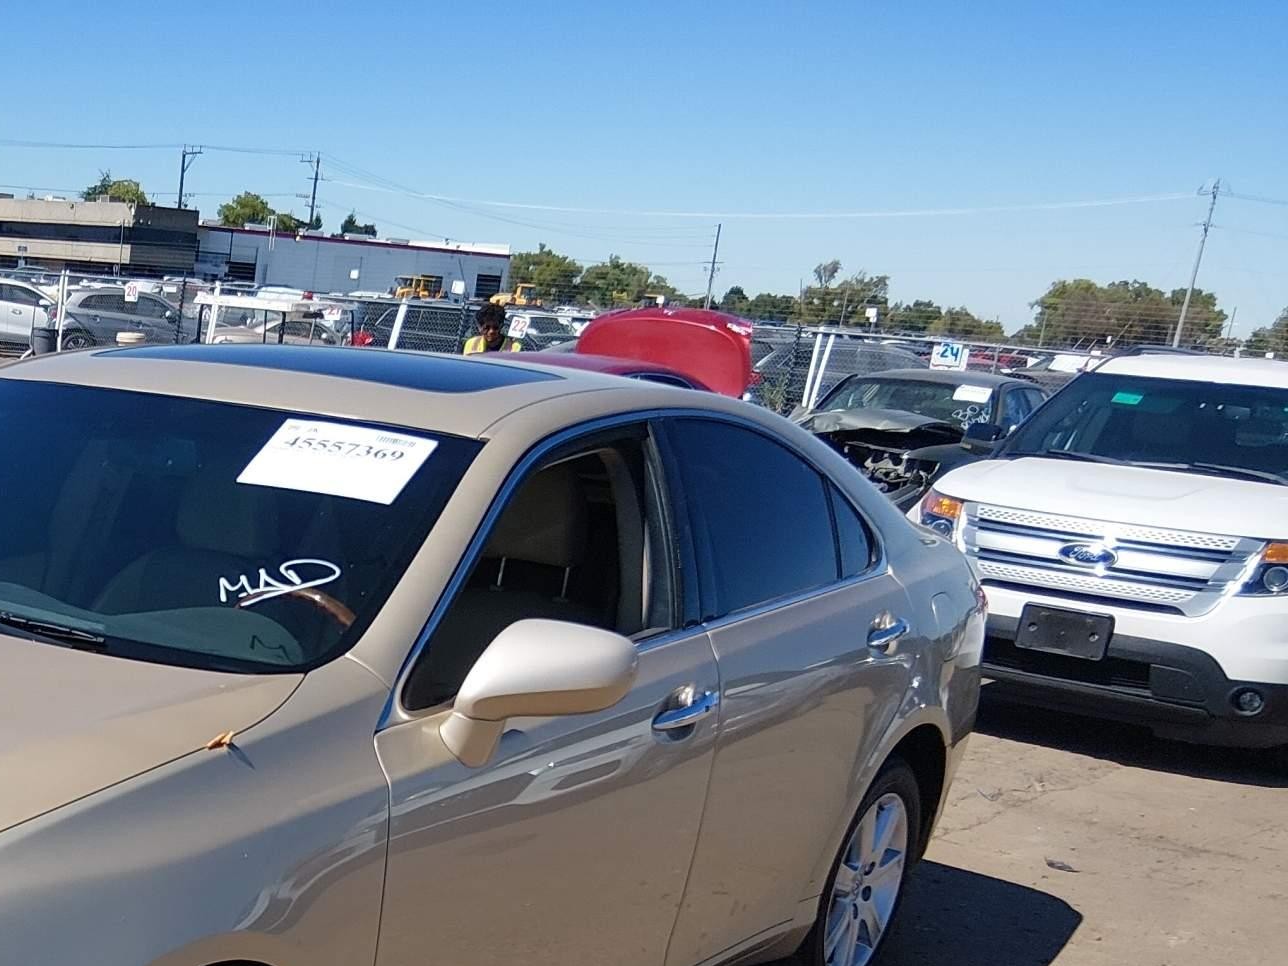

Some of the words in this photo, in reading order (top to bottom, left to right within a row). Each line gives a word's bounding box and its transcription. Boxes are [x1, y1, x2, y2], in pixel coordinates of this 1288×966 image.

[126, 285, 137, 297] 20
[511, 319, 527, 333] 22
[939, 342, 960, 362] 24
[283, 436, 405, 461] 45557369
[219, 558, 341, 607] MAD
